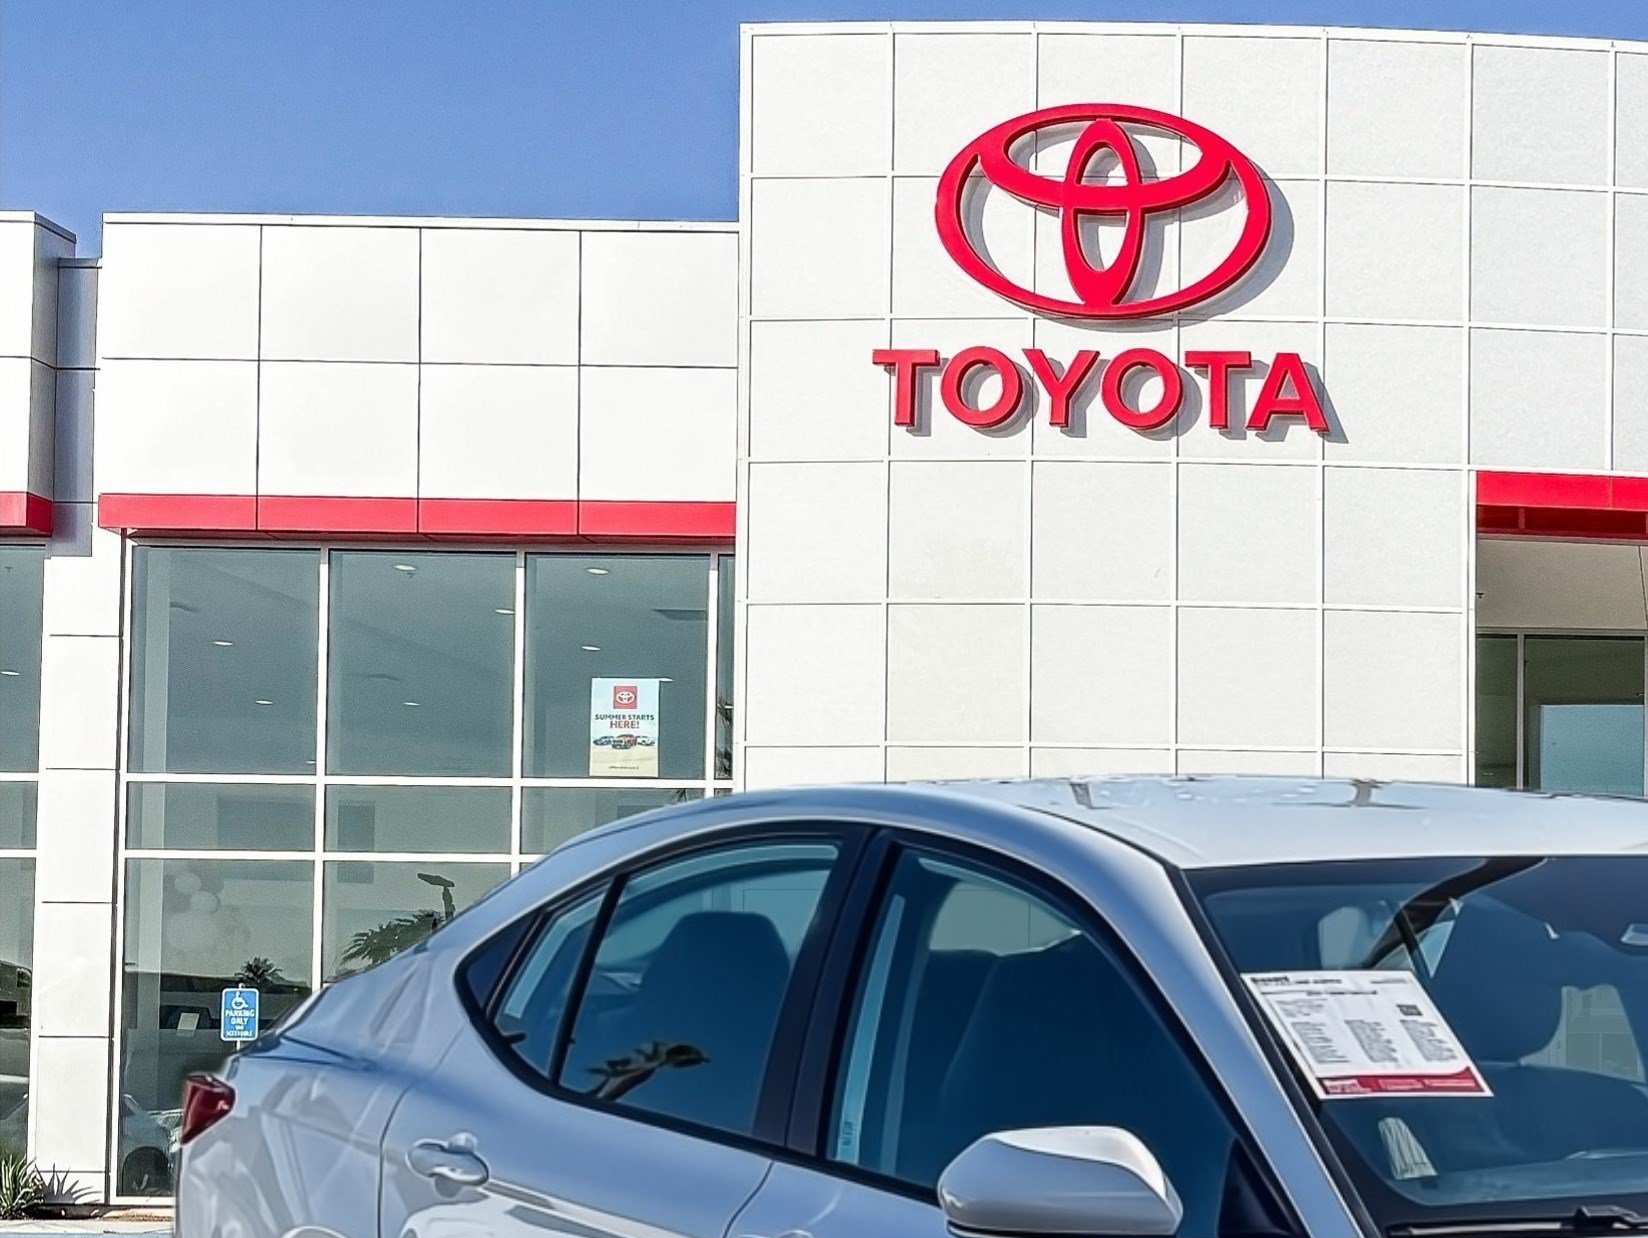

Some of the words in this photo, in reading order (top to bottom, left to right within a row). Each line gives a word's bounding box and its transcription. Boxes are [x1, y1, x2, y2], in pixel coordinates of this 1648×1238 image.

[872, 345, 1331, 432] TOYOTA
[609, 721, 640, 729] HERE!
[231, 1017, 249, 1025] ONLY
